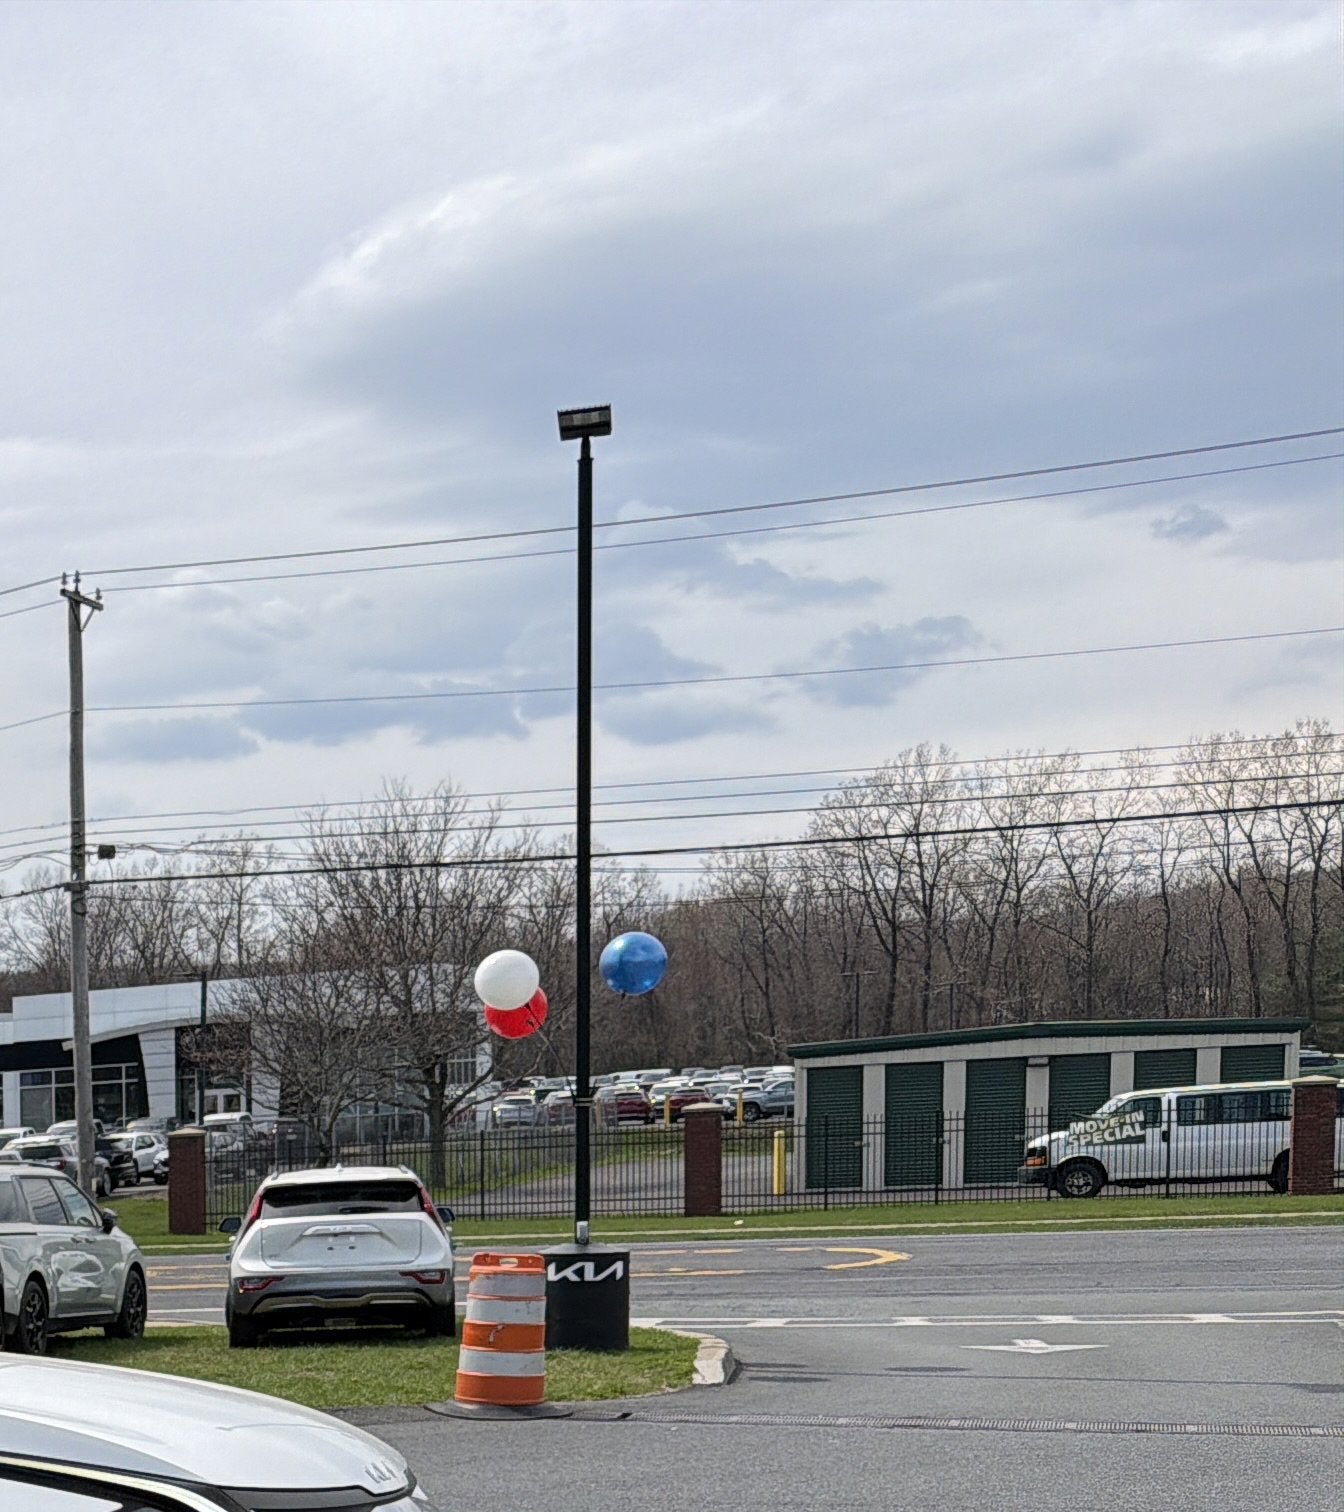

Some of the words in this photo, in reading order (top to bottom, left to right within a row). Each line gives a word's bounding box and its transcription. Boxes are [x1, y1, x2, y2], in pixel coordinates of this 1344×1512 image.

[1068, 1122, 1146, 1147] SPECIAL
[1069, 1109, 1146, 1135] MOVE-IN
[547, 1261, 624, 1282] KIA
